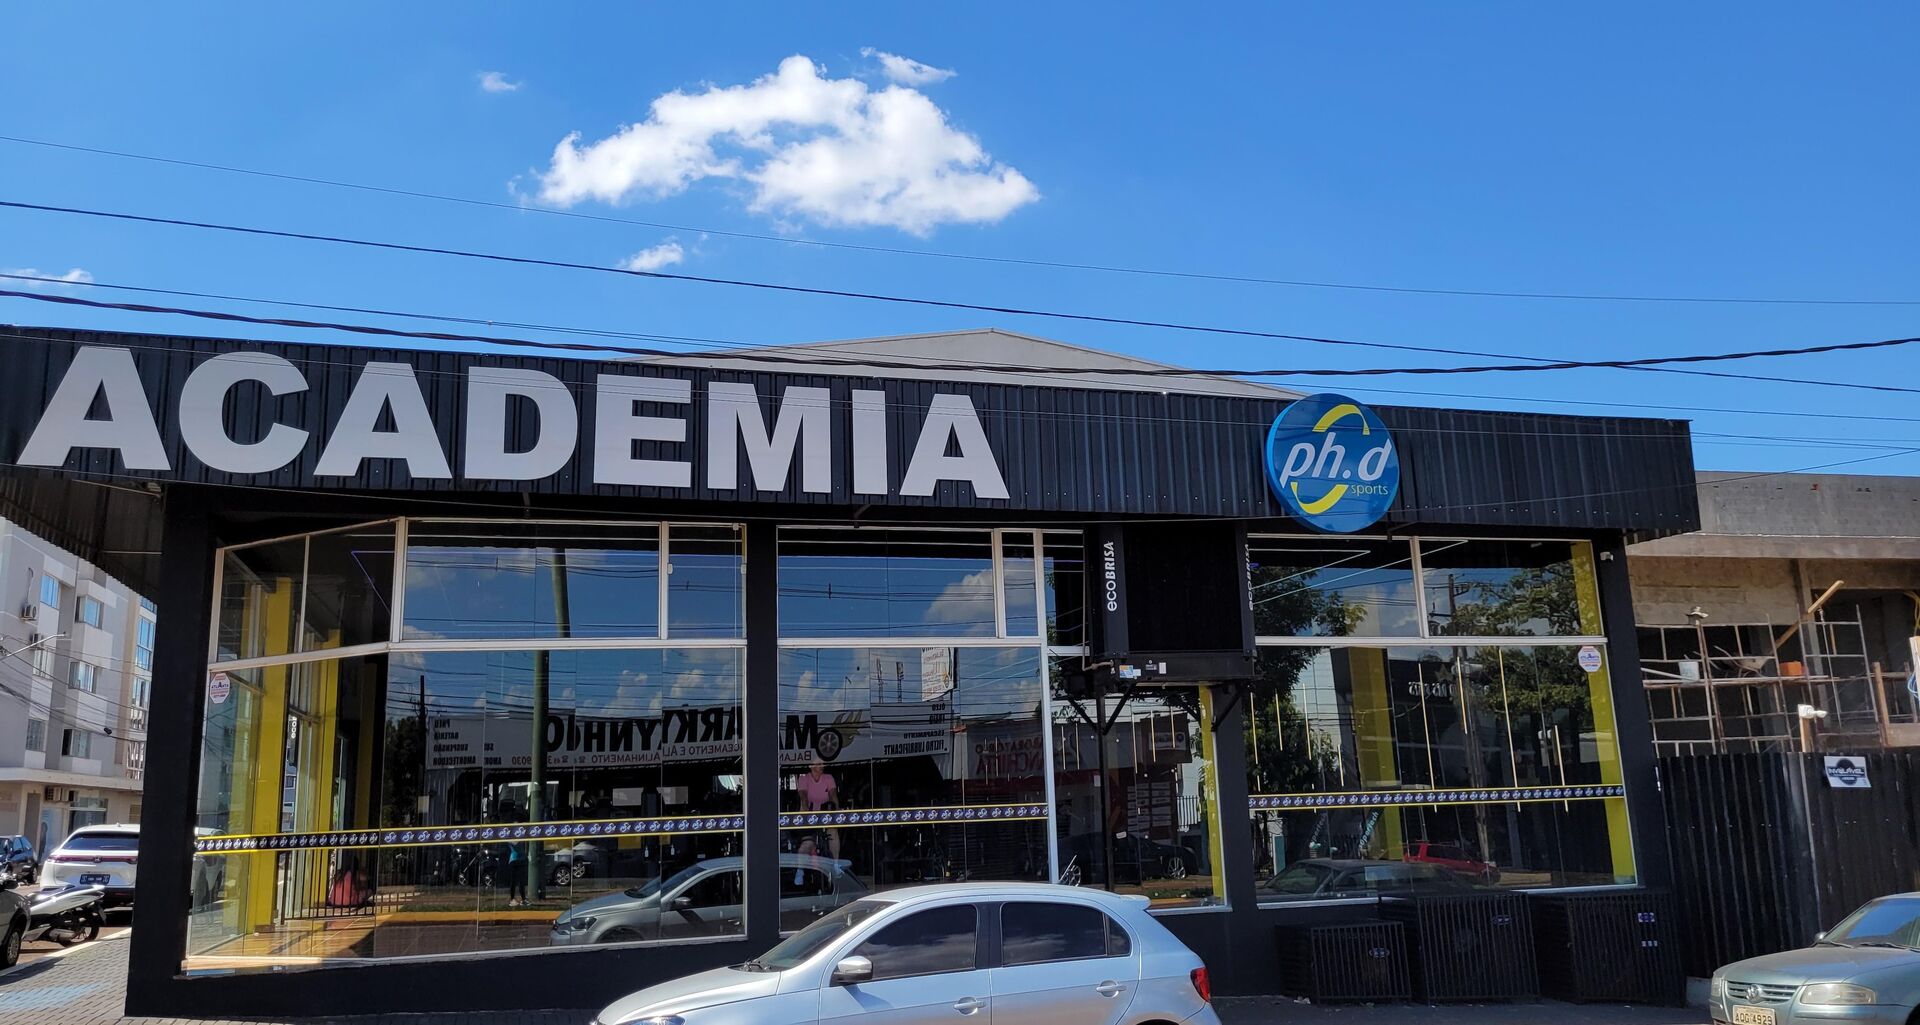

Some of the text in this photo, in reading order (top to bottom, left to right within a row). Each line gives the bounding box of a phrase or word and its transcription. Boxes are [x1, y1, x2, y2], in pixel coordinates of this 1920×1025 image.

[16, 345, 1010, 499] ACADEMIA
[1280, 432, 1392, 488] ph.d
[1351, 484, 1388, 496] sports
